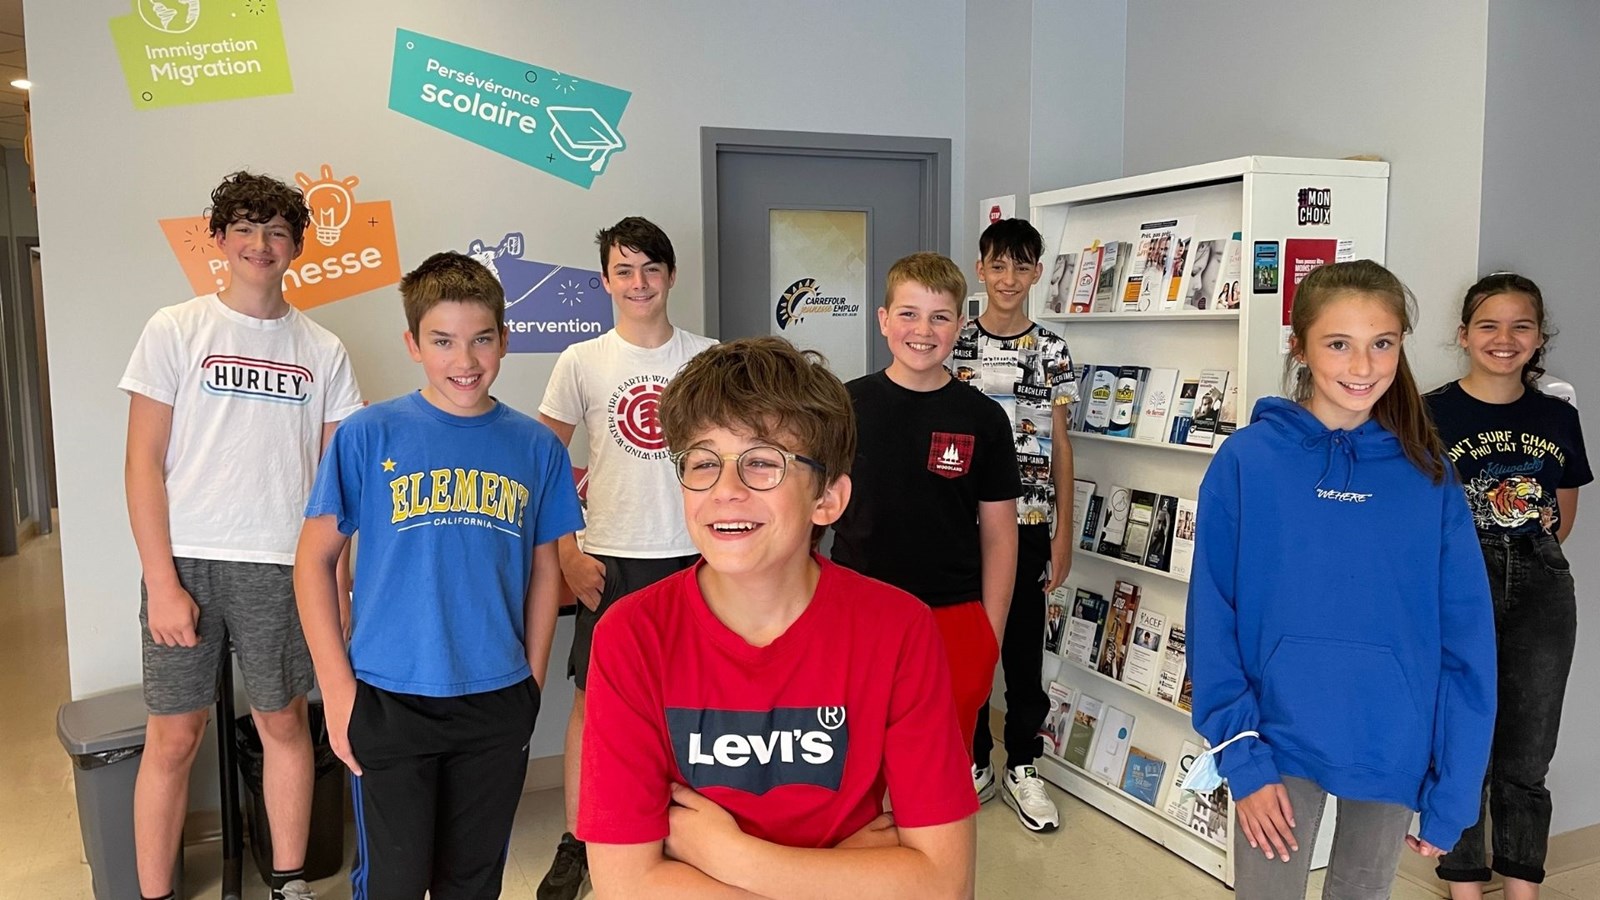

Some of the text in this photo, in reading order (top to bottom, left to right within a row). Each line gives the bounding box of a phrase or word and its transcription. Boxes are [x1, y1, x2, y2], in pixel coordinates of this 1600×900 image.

[145, 38, 258, 60] Immigration
[150, 57, 261, 86] Migration
[426, 58, 540, 107] Persévérance
[420, 83, 537, 134] scolaire
[1300, 207, 1330, 224] CHOIX
[805, 297, 846, 305] CARREFOUR
[833, 304, 860, 312] EMPLOI
[504, 319, 601, 333] tervention
[215, 365, 302, 395] HURLEY
[618, 375, 649, 392] EARTH
[652, 375, 670, 385] WIN
[608, 392, 620, 413] FIRE
[608, 416, 624, 447] WATER
[625, 442, 651, 460] WIND
[1448, 438, 1473, 462] ON'T
[1478, 431, 1512, 444] SURF
[1470, 442, 1545, 460] PHU CAT 1967
[389, 468, 530, 528] ELEMENT
[433, 517, 493, 529] CALIFORNIA
